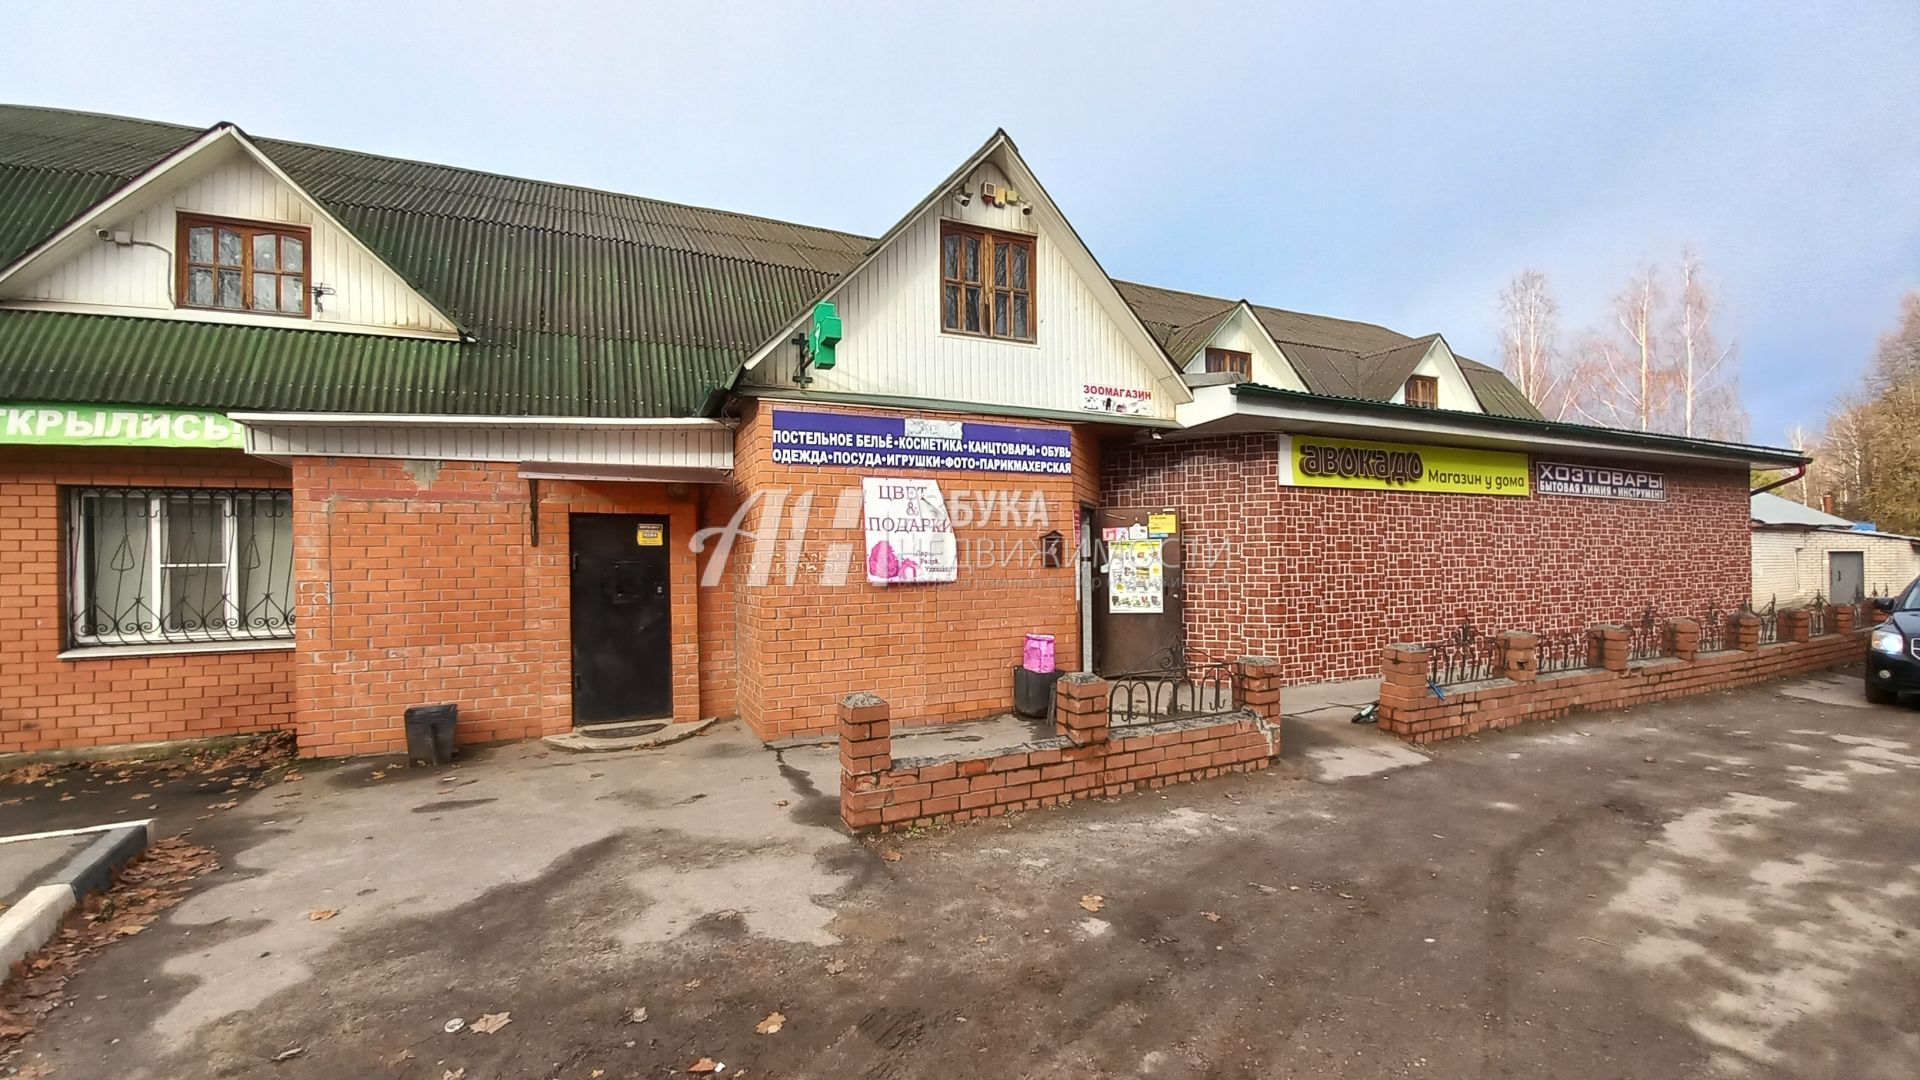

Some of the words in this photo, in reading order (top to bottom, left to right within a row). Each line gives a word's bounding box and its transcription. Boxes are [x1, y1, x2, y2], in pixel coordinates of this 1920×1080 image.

[1083, 384, 1152, 400] ЗООМАГАЗИН
[0, 408, 243, 441] КРЫЛИСЬ!
[773, 429, 853, 447] ПОСТЕЛЬНОЕ
[856, 433, 893, 448] БЕЛЬЁ
[899, 436, 963, 452] КОСМЕТИКА
[968, 440, 1036, 456] КАНЦТОВАРЫ
[1041, 445, 1071, 458] ОБУВЬ
[772, 448, 828, 465] ОДЕЖДА
[833, 451, 882, 466] ПОСУДА
[886, 453, 940, 468] ИГРУШКИ
[945, 456, 975, 469] ФОТО
[980, 458, 1071, 474] ПАРИКМАХЕРСКАЯ
[1299, 443, 1424, 484] авокадо
[1428, 468, 1482, 485] Магазин
[1485, 475, 1492, 489] у
[1495, 475, 1525, 490] дома
[1540, 464, 1663, 489] ХОЗТОВАРЫ
[1540, 480, 1580, 494] БЫТОВАЯ
[1582, 484, 1612, 497] ХИМИЯ
[1618, 488, 1663, 499] ИНСТРУМЕНТ
[868, 517, 954, 534] ПОДАРКИ
